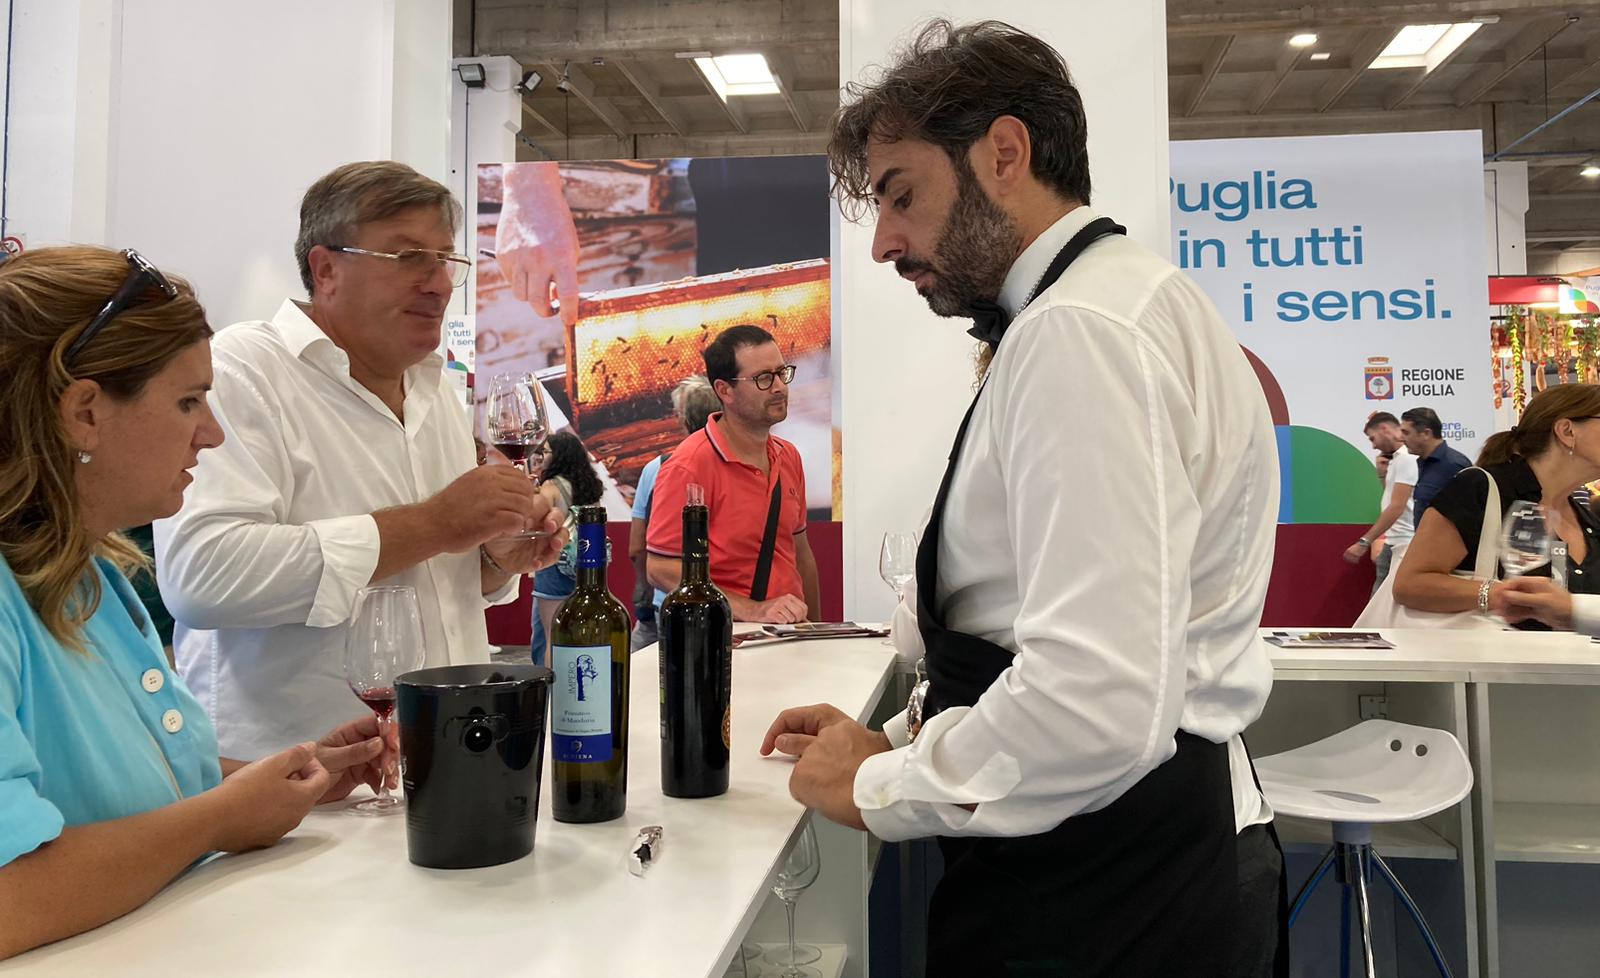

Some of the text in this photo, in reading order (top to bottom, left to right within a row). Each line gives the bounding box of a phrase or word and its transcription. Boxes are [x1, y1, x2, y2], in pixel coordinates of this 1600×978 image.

[1169, 170, 1317, 222] uglia
[1179, 225, 1363, 269] in tutti
[1243, 279, 1452, 323] i sensi.
[448, 320, 464, 329] glia
[1402, 368, 1465, 381] REGIONE
[1402, 384, 1455, 397] PUGLIA
[568, 661, 576, 694] IMPERO
